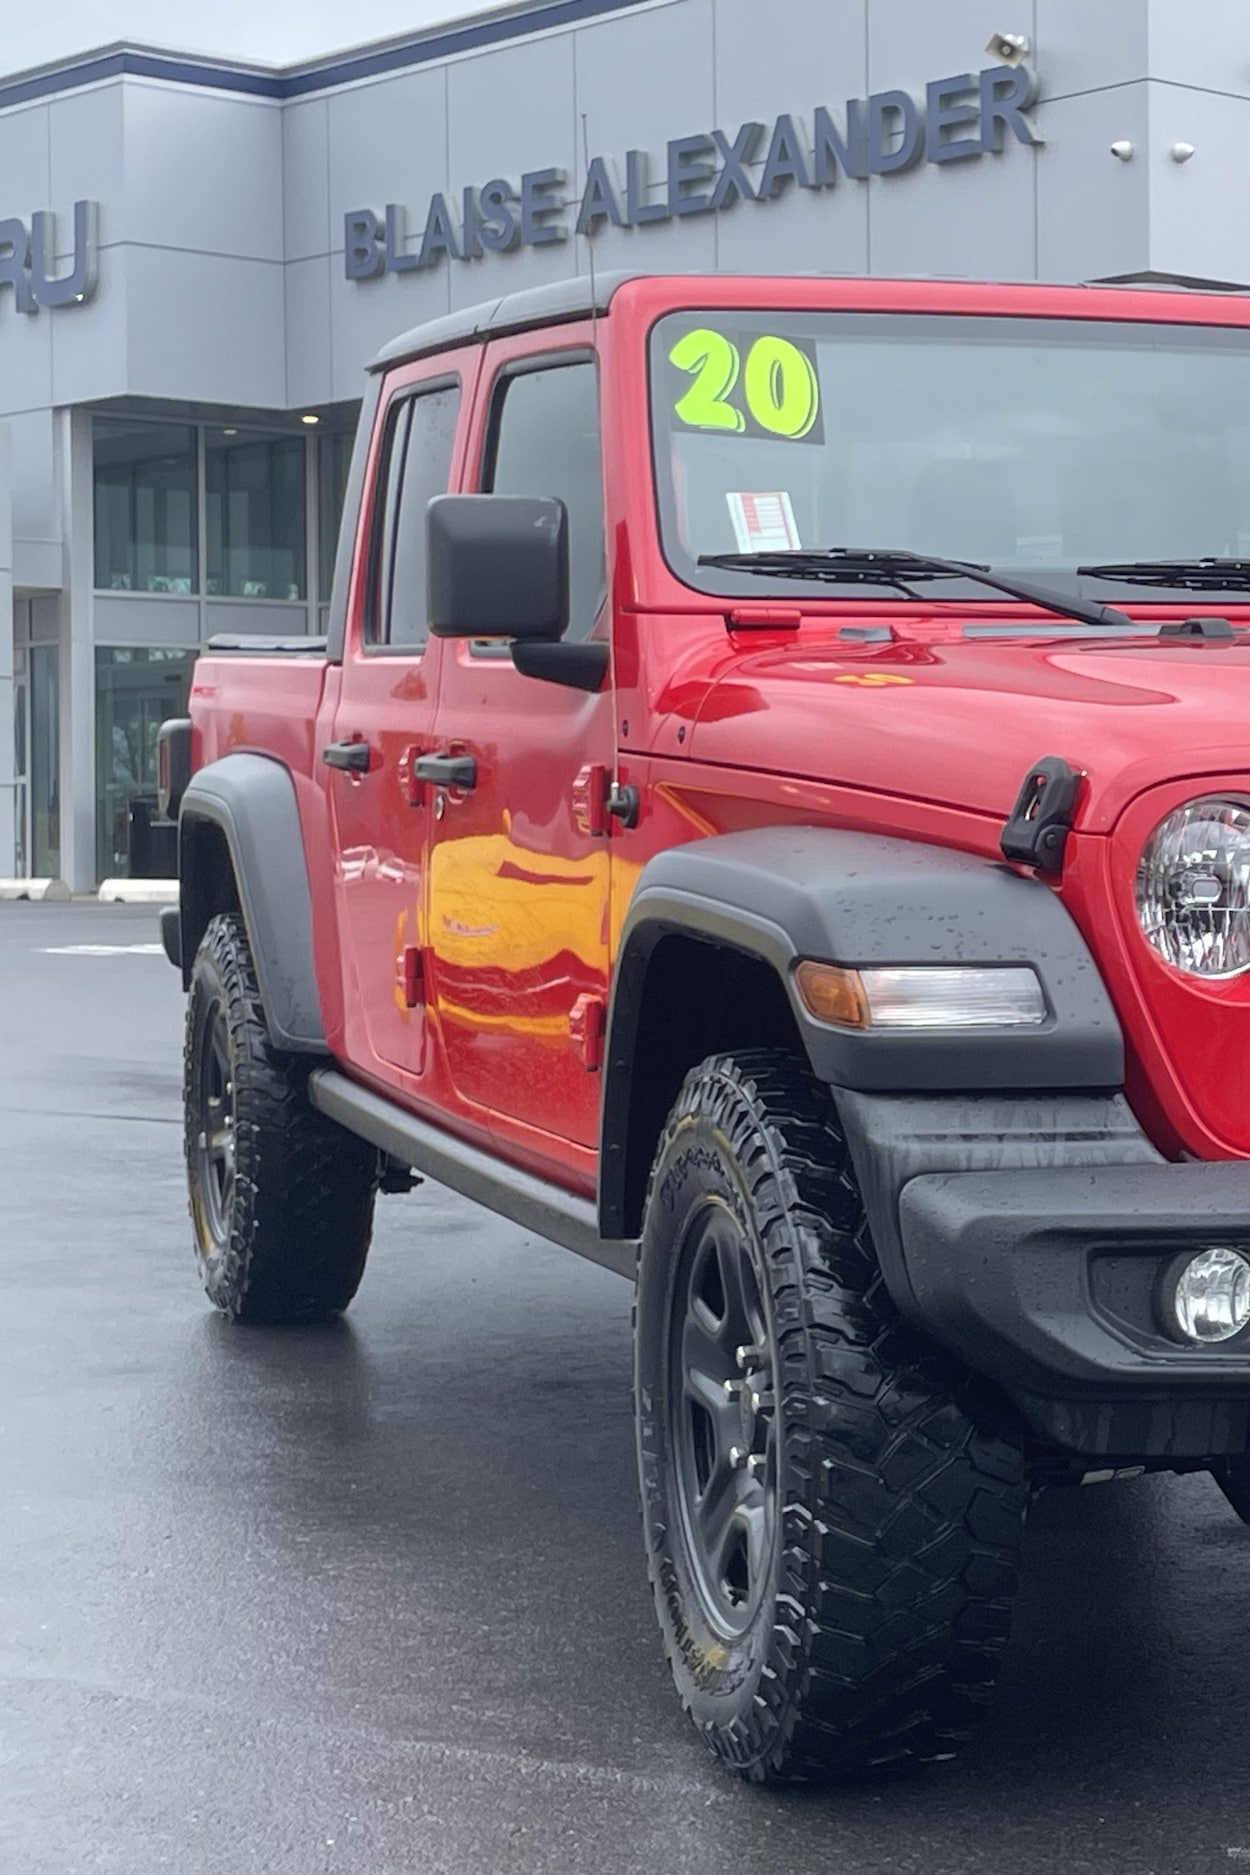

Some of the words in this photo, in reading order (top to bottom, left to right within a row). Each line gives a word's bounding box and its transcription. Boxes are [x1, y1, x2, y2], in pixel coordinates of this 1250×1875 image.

[344, 166, 568, 281] BLAISE
[575, 64, 1046, 236] ALEXANDER
[668, 328, 819, 439] 20
